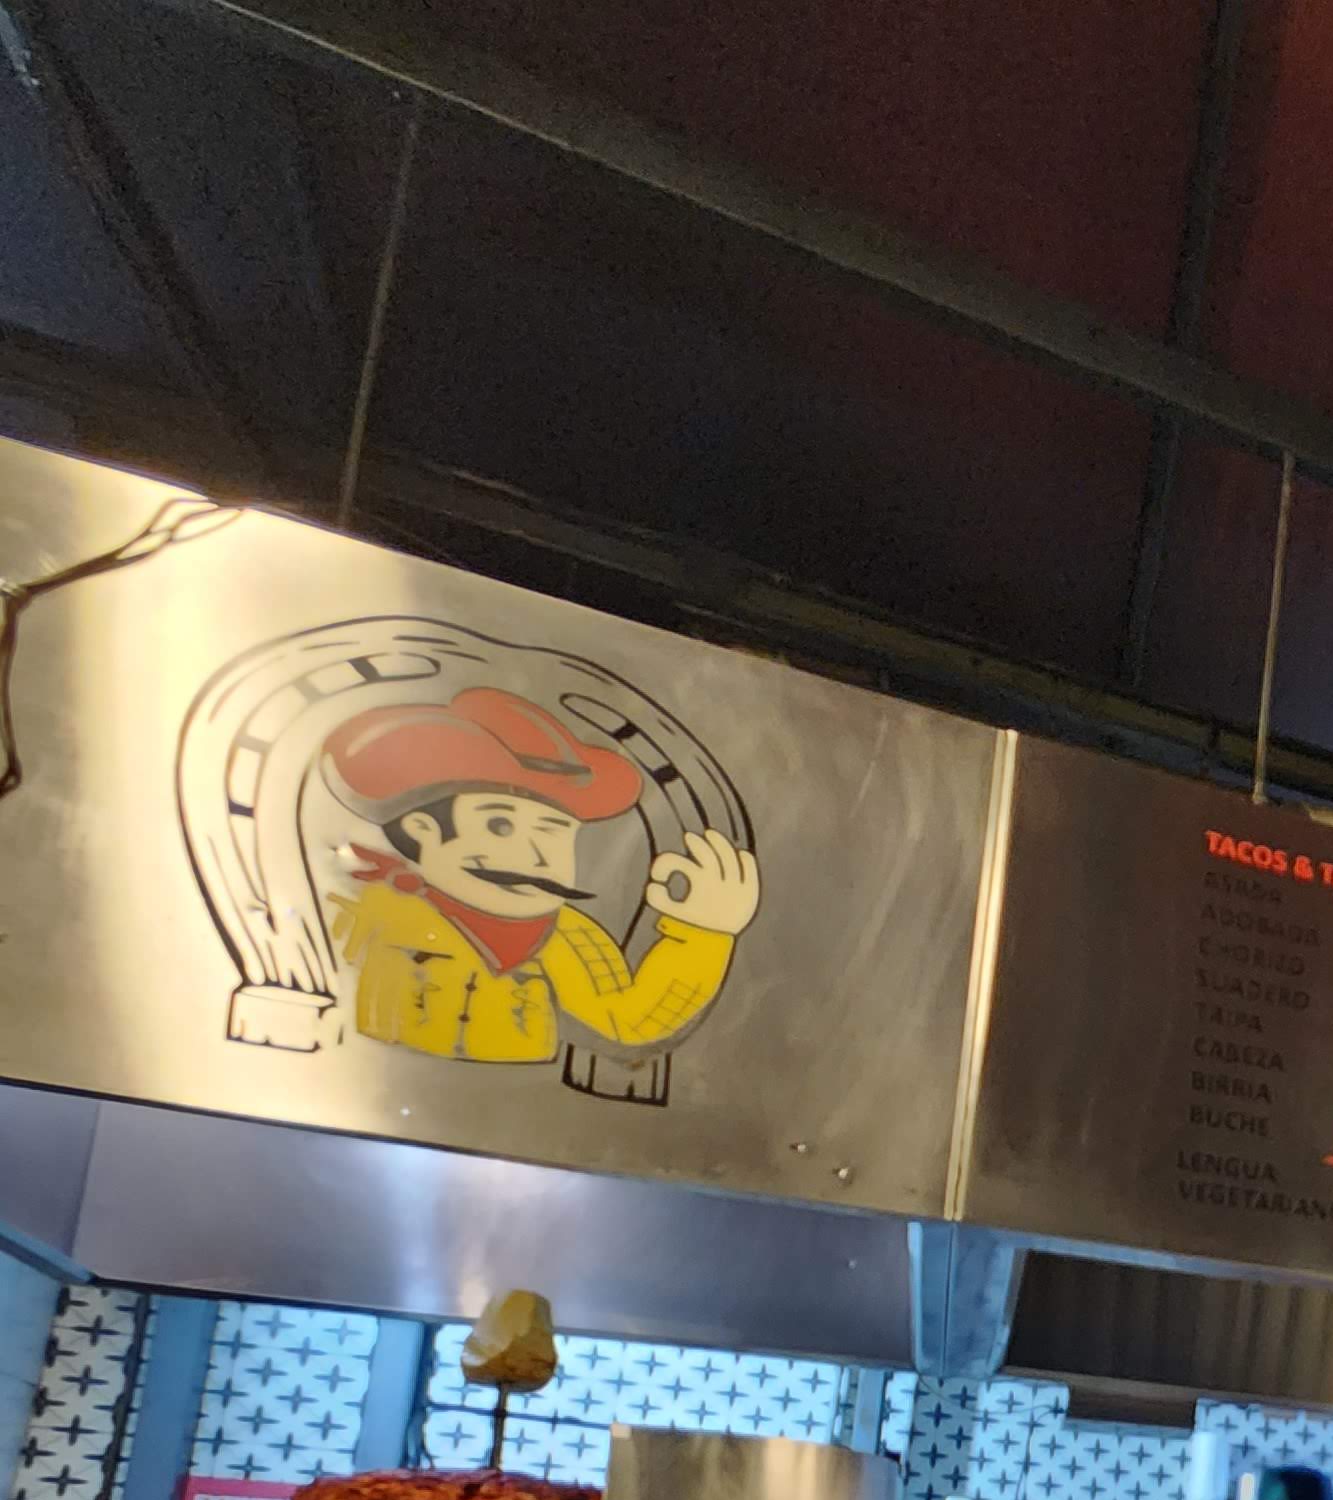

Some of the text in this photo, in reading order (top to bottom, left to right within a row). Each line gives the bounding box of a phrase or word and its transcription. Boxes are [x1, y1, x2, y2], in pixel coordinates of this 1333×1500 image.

[1204, 831, 1288, 876] TACOS
[1293, 855, 1315, 884] &
[1192, 1036, 1285, 1072] CABEZA
[1191, 1071, 1273, 1105] BIRRIA
[1188, 1104, 1270, 1137] BUCHE
[1176, 1150, 1279, 1185] LENGUA
